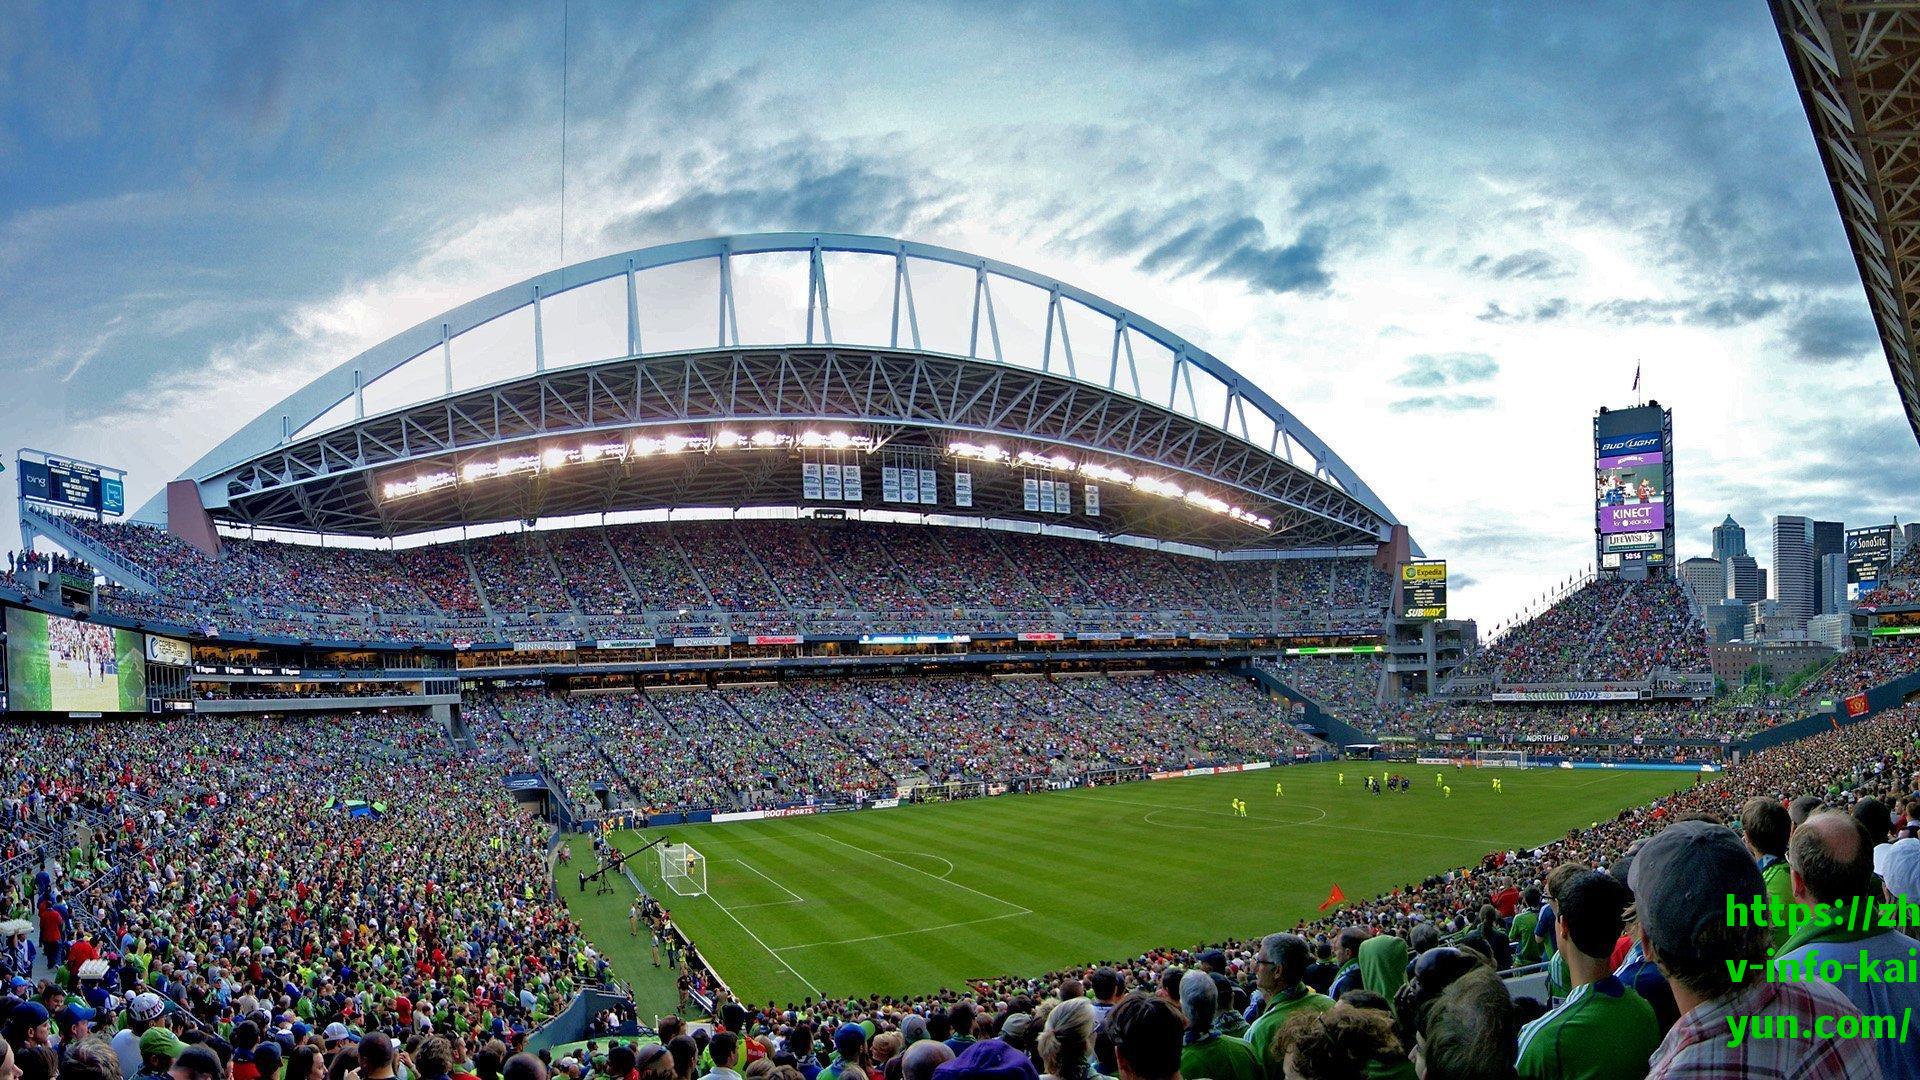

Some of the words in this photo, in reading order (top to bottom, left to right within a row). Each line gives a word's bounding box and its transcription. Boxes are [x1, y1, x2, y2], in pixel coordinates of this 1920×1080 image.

[1628, 438, 1658, 447] LIGHT
[26, 474, 46, 487] bing
[1613, 508, 1650, 519] KINECT
[1858, 536, 1886, 549] SonoSite
[1417, 569, 1442, 577] Expedia
[1405, 608, 1445, 617] SUBWAY
[519, 641, 565, 650] PINNACLE
[764, 809, 786, 818] ROOT
[786, 808, 813, 816] SPORTS
